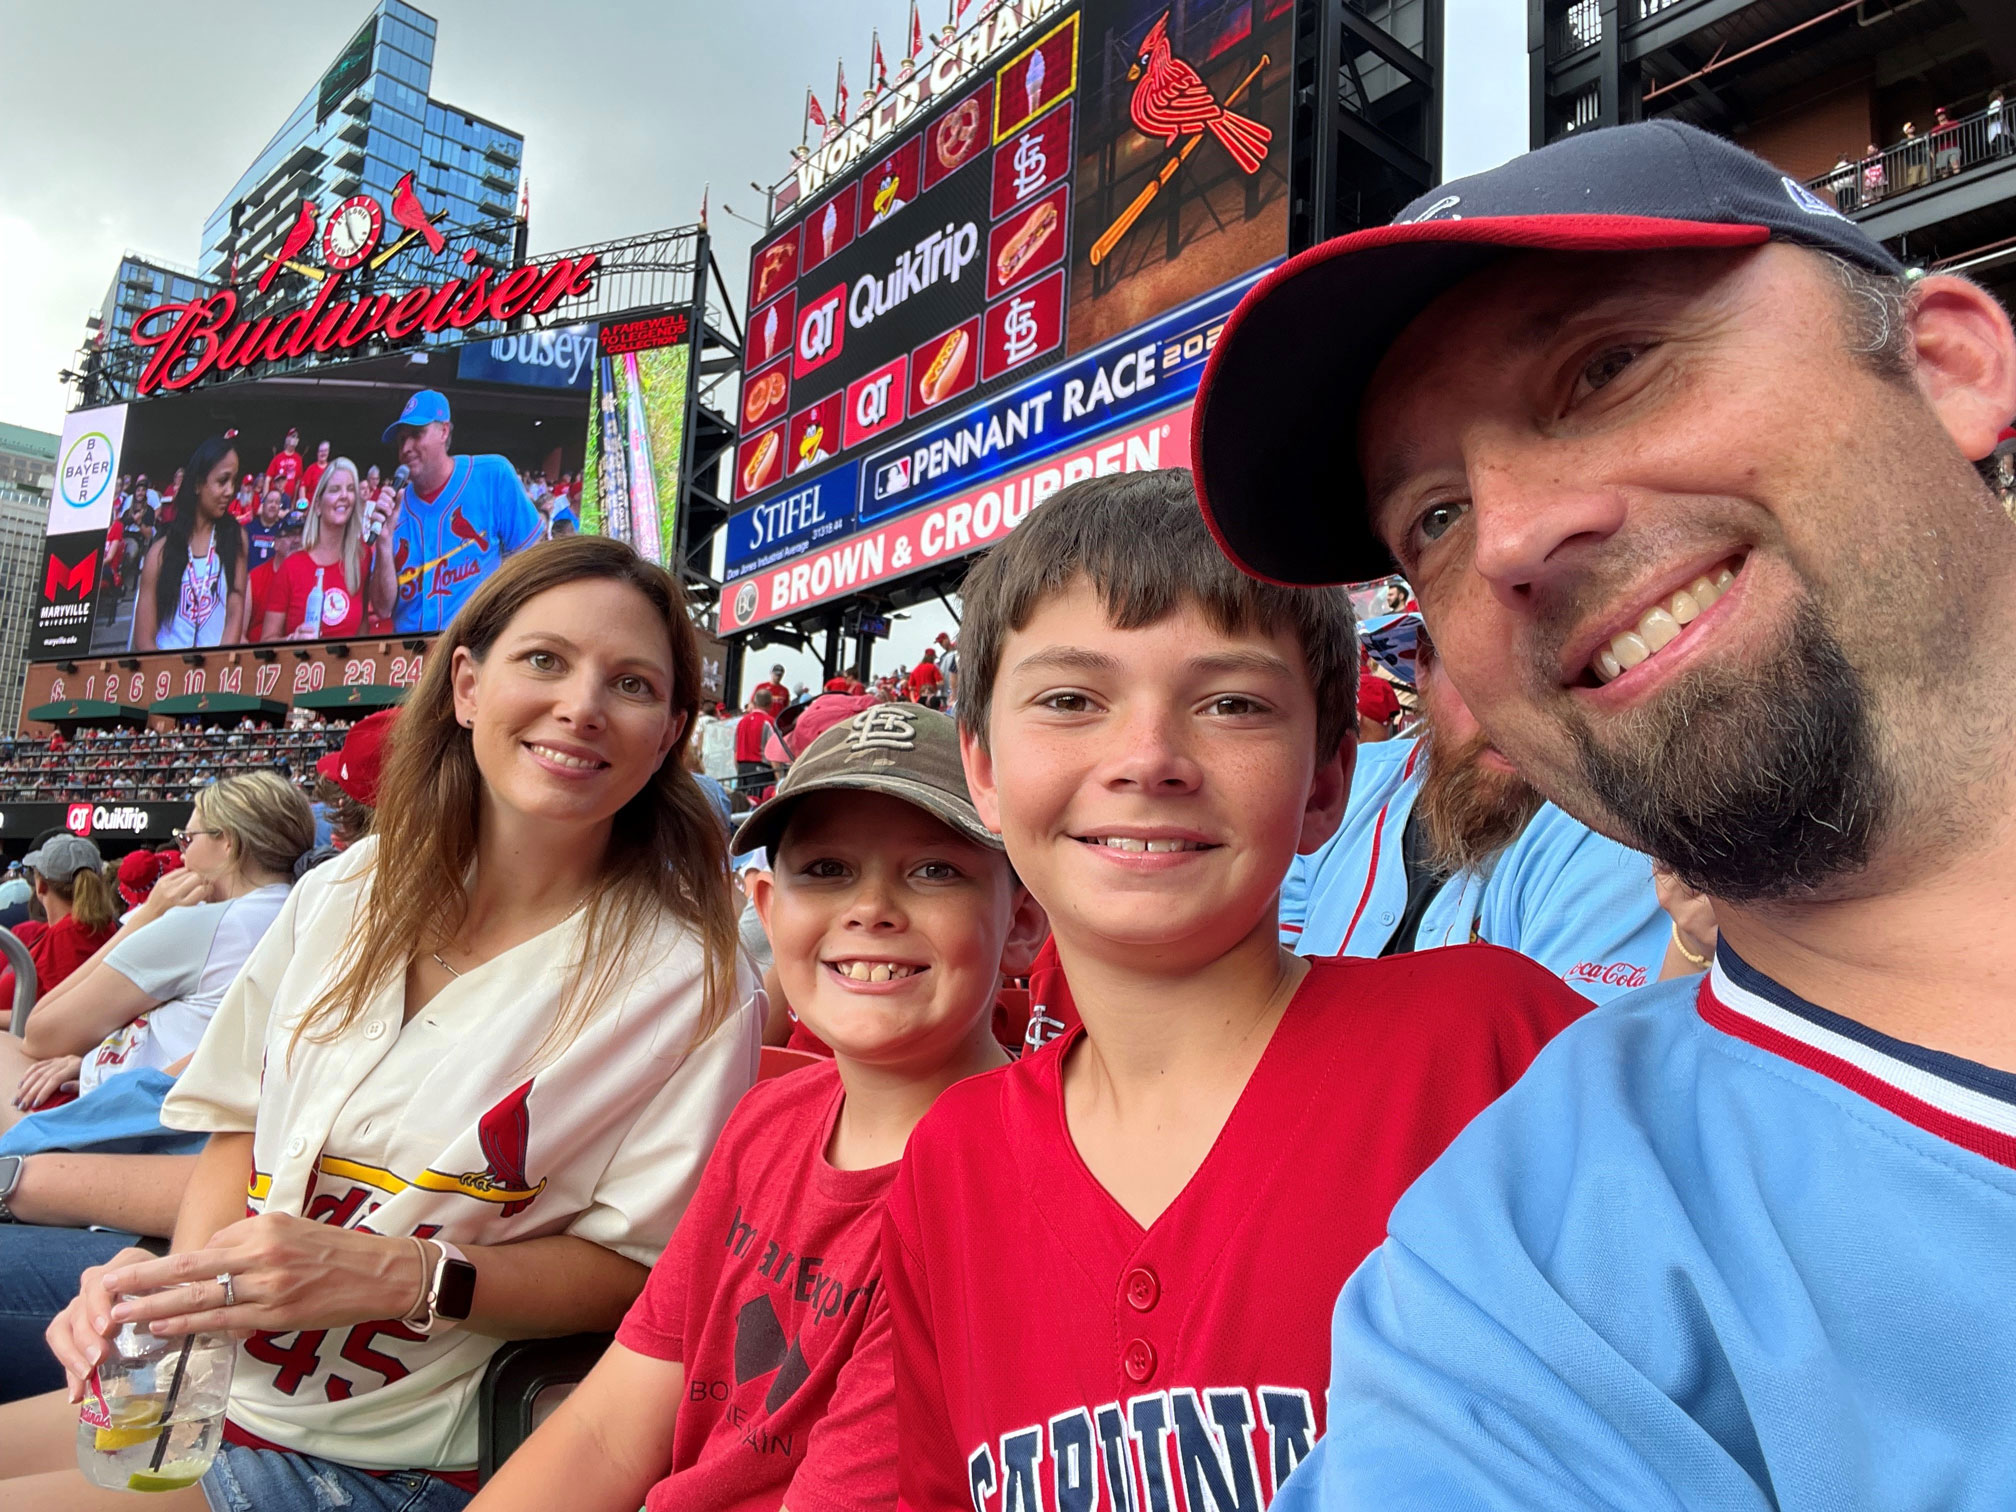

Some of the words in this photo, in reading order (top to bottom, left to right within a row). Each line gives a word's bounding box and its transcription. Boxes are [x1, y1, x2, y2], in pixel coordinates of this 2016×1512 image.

[797, 82, 921, 203] WORLD
[800, 297, 839, 361] QT
[848, 222, 978, 329] QuikTrip
[130, 248, 598, 396] Budweiser
[600, 326, 612, 338] A
[613, 314, 689, 334] FAREWELL
[600, 334, 619, 347] TO
[620, 323, 687, 344] LEGENDS
[606, 336, 679, 354] COLLECTION
[857, 373, 893, 428] QT
[912, 391, 1053, 486] PENNANT
[1063, 342, 1158, 423] RACE
[65, 461, 110, 479] BAYER
[750, 484, 826, 550] STIFEL
[426, 557, 481, 600] Louis
[771, 533, 886, 611] BROWN
[890, 536, 912, 569] &
[40, 602, 91, 619] MARYVILLE
[86, 675, 96, 701] 1
[104, 674, 120, 703] 2
[128, 672, 145, 703] 6
[155, 671, 171, 701] 9
[183, 668, 207, 696] 10
[218, 666, 246, 695] 14
[255, 664, 282, 697] 17
[293, 661, 326, 694] 20
[343, 658, 376, 687] 23
[388, 655, 424, 688] 24
[69, 808, 90, 831] QT
[92, 806, 149, 834] QuikTrip
